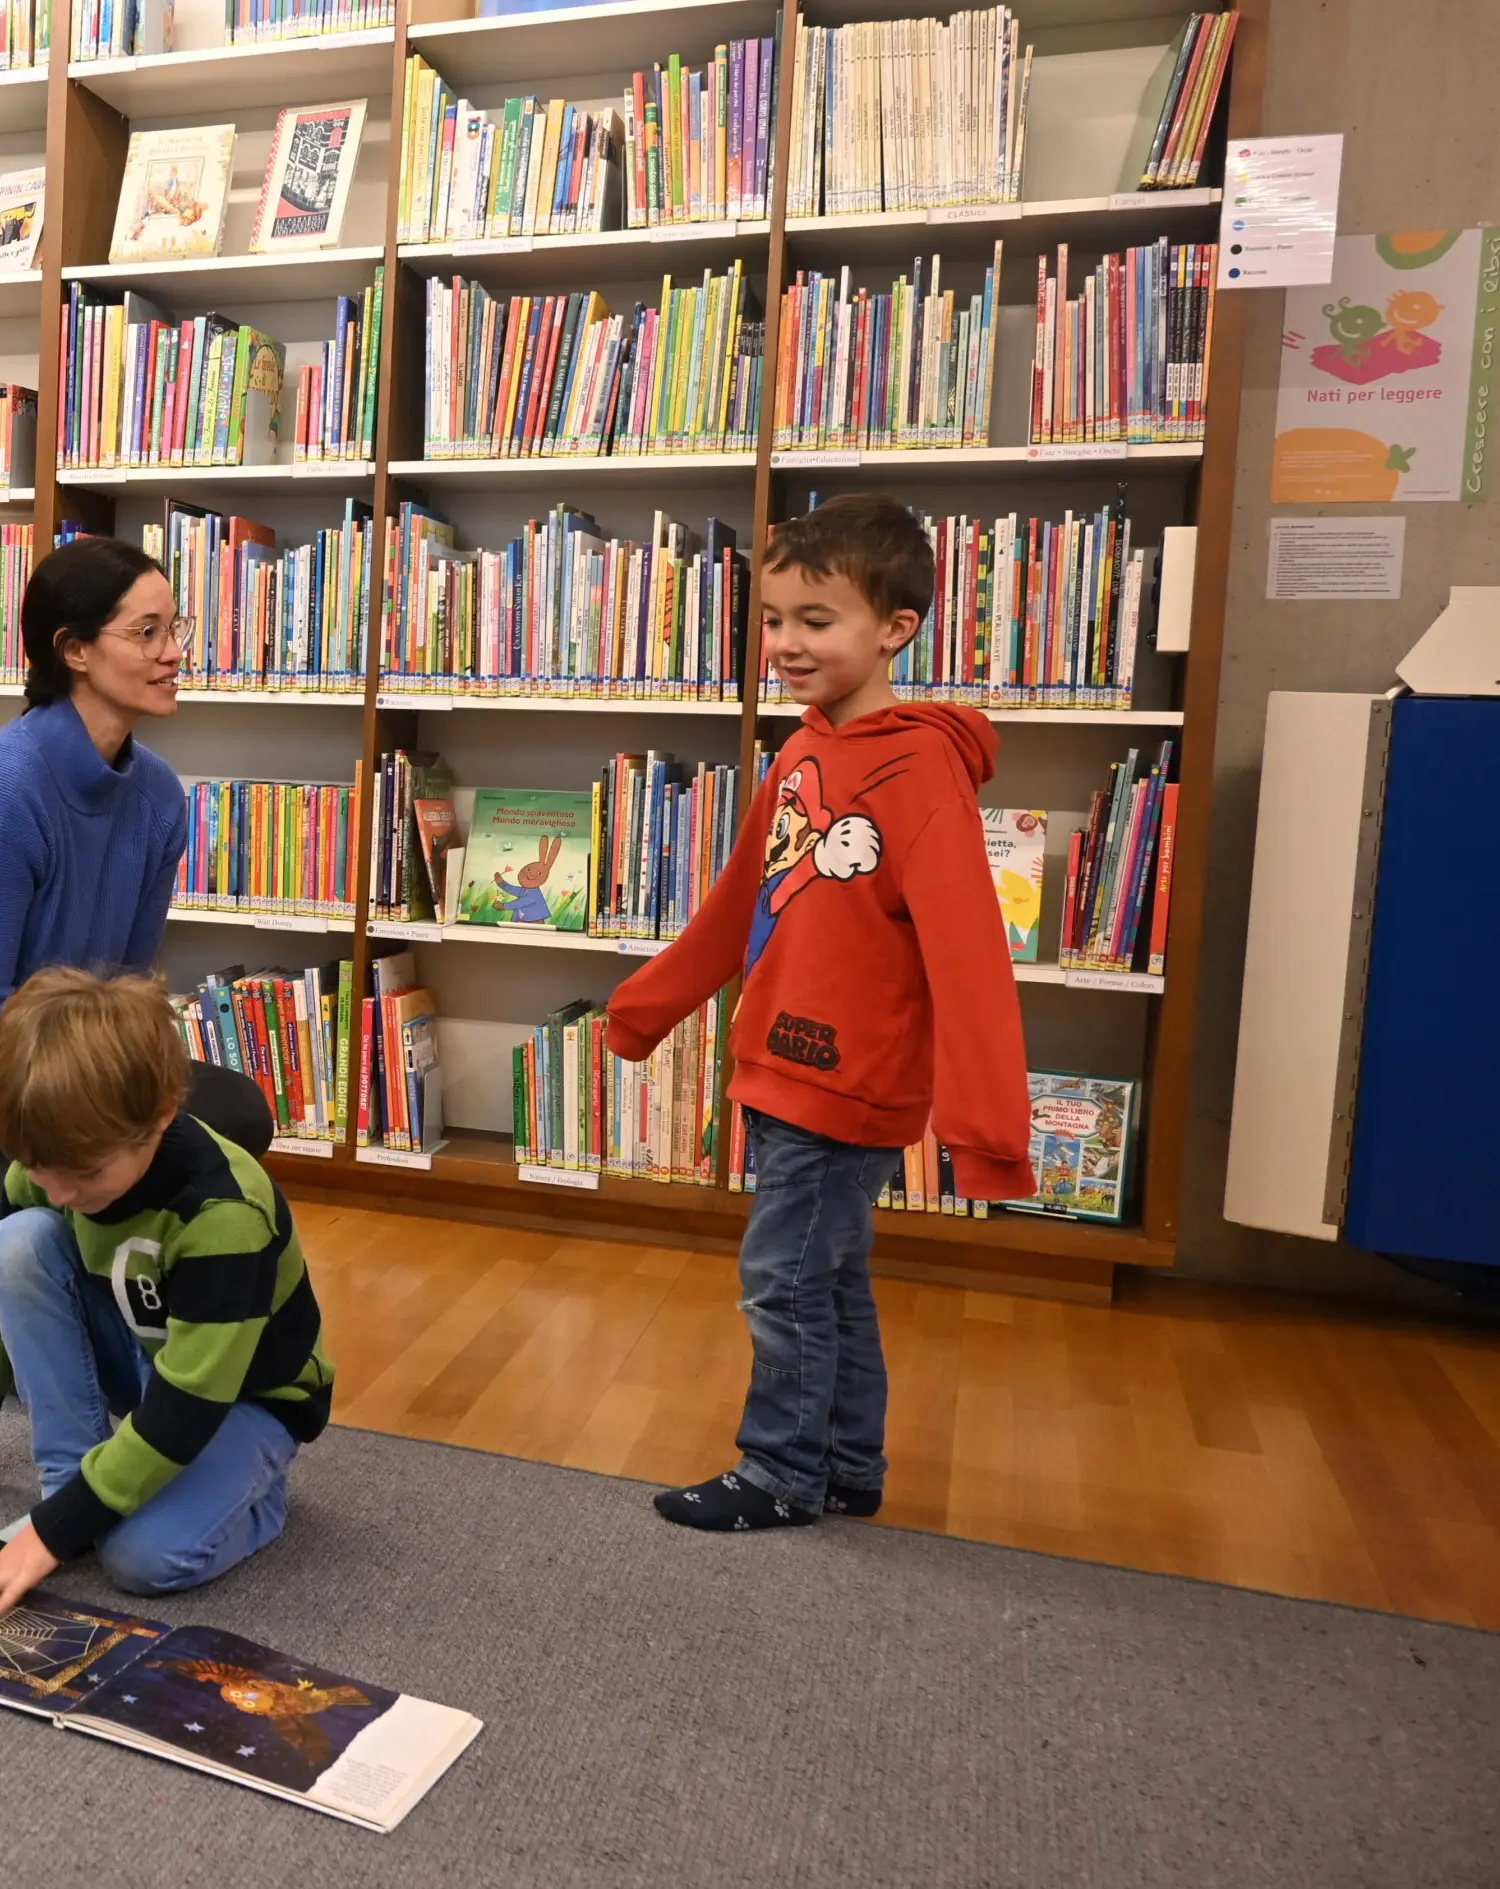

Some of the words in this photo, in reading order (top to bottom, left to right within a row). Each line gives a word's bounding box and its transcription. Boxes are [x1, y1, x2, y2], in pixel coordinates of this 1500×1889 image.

[947, 209, 987, 219] CLASSICI
[1307, 389, 1340, 403] Nati
[1347, 391, 1375, 404] per
[1380, 387, 1442, 404] leggere
[1466, 384, 1489, 493] Crescere
[1481, 327, 1494, 369] con
[496, 807, 525, 816] Mondo
[527, 809, 575, 818] spaventoso
[492, 816, 521, 825] Mondo
[522, 817, 576, 828] meraviglioso
[1161, 824, 1172, 859] bambini
[988, 850, 1011, 858] sei?
[1161, 860, 1171, 874] per
[1159, 875, 1168, 893] Arte
[1075, 977, 1091, 985] Arte
[226, 1036, 237, 1049] LO
[766, 1028, 841, 1071] MARIO
[229, 1052, 238, 1066] SO
[338, 1037, 347, 1078] GRANDI
[337, 1080, 346, 1118] EDIFICI
[360, 1074, 369, 1111] DOTTORE?
[1042, 1105, 1069, 1114] PRIMO
[1070, 1107, 1095, 1116] LIBRO
[1056, 1100, 1064, 1108] IL
[1065, 1100, 1082, 1108] TUO
[1055, 1113, 1081, 1122] DELLA
[1044, 1119, 1089, 1130] MONTAGNA
[941, 1151, 950, 1162] LO
[529, 1172, 551, 1183] Natura
[111, 1236, 168, 1340] C
